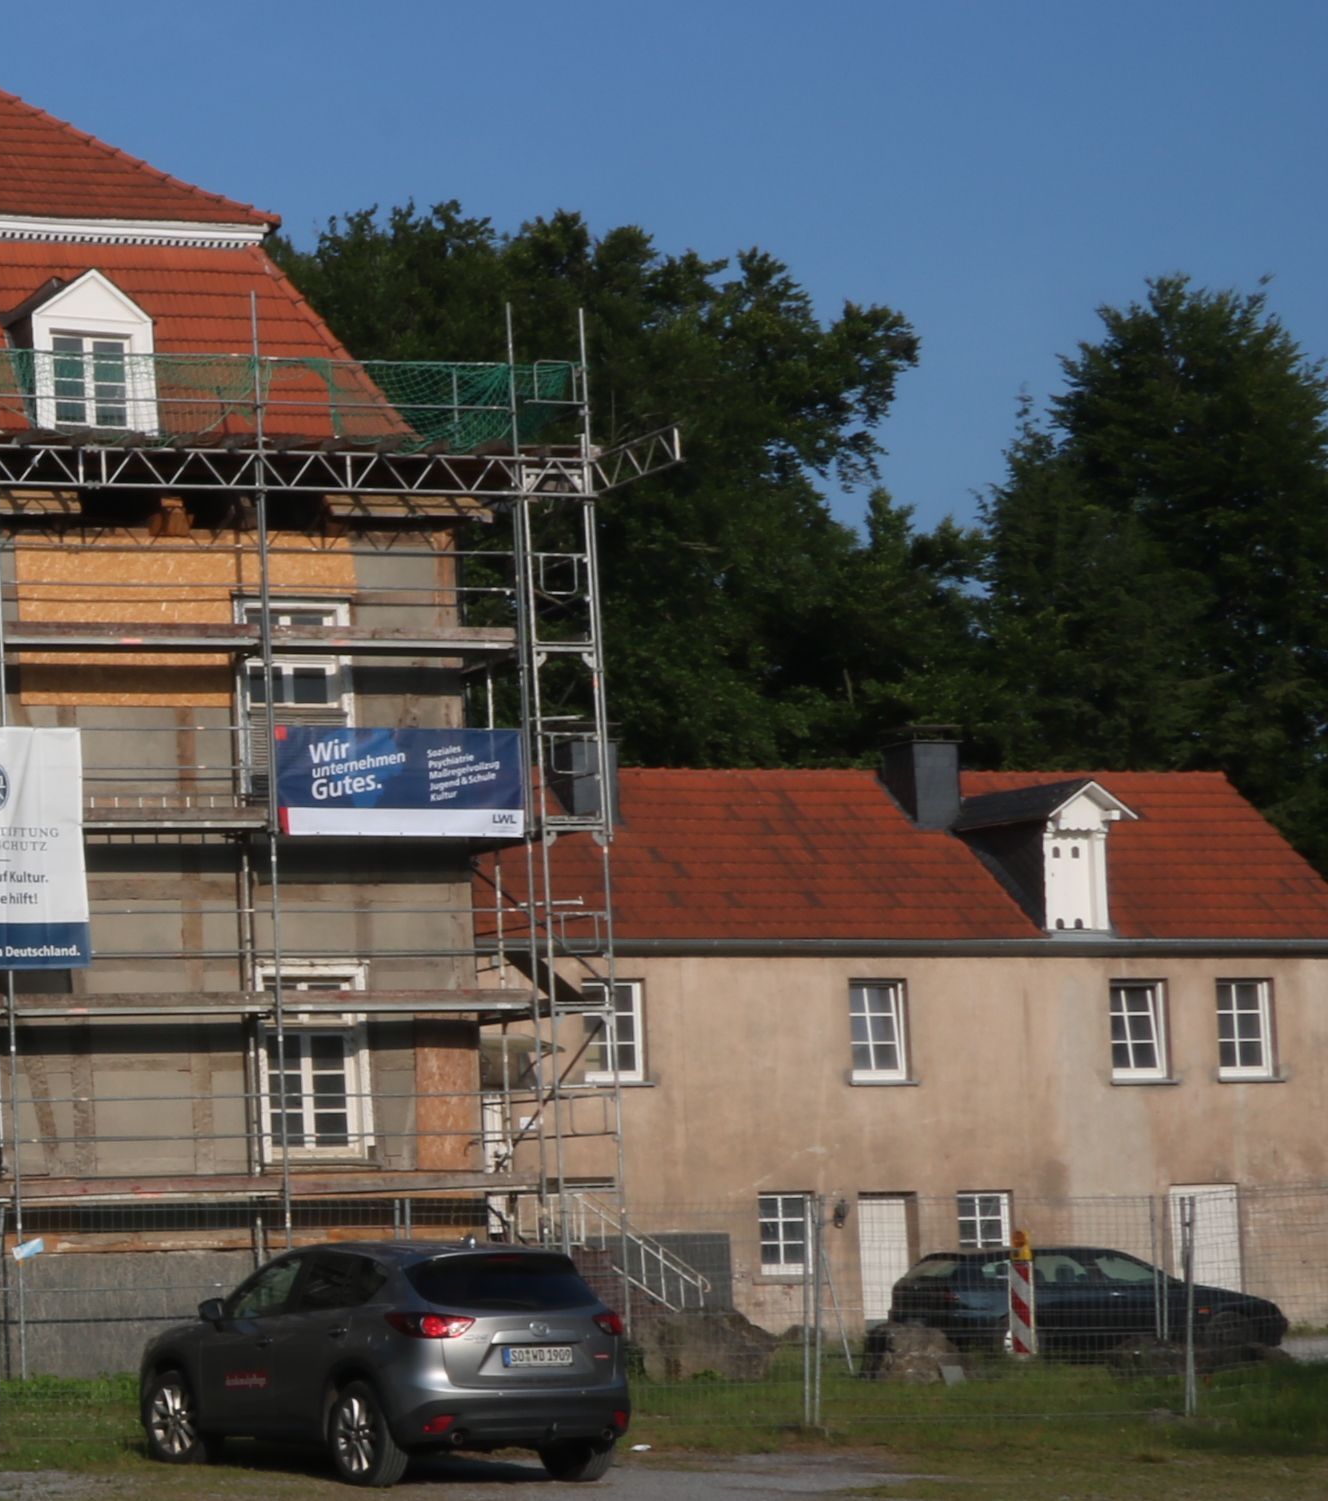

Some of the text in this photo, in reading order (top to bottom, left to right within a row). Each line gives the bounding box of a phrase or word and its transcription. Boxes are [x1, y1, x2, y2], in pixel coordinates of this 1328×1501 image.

[308, 739, 349, 763] Wir
[426, 745, 461, 758] Soziales
[312, 751, 406, 778] unternehmen
[428, 754, 474, 768] Psychiatrie
[428, 759, 500, 778] Maßregelvollzug
[312, 774, 382, 800] Gutes.
[429, 771, 496, 791] Jugend & Schule
[430, 790, 457, 801] Kultur
[492, 814, 516, 824] LWL
[9, 872, 48, 883] Kultur.
[9, 892, 38, 904] hilft!
[6, 945, 80, 957] Deutschland.
[547, 1349, 570, 1361] 1909
